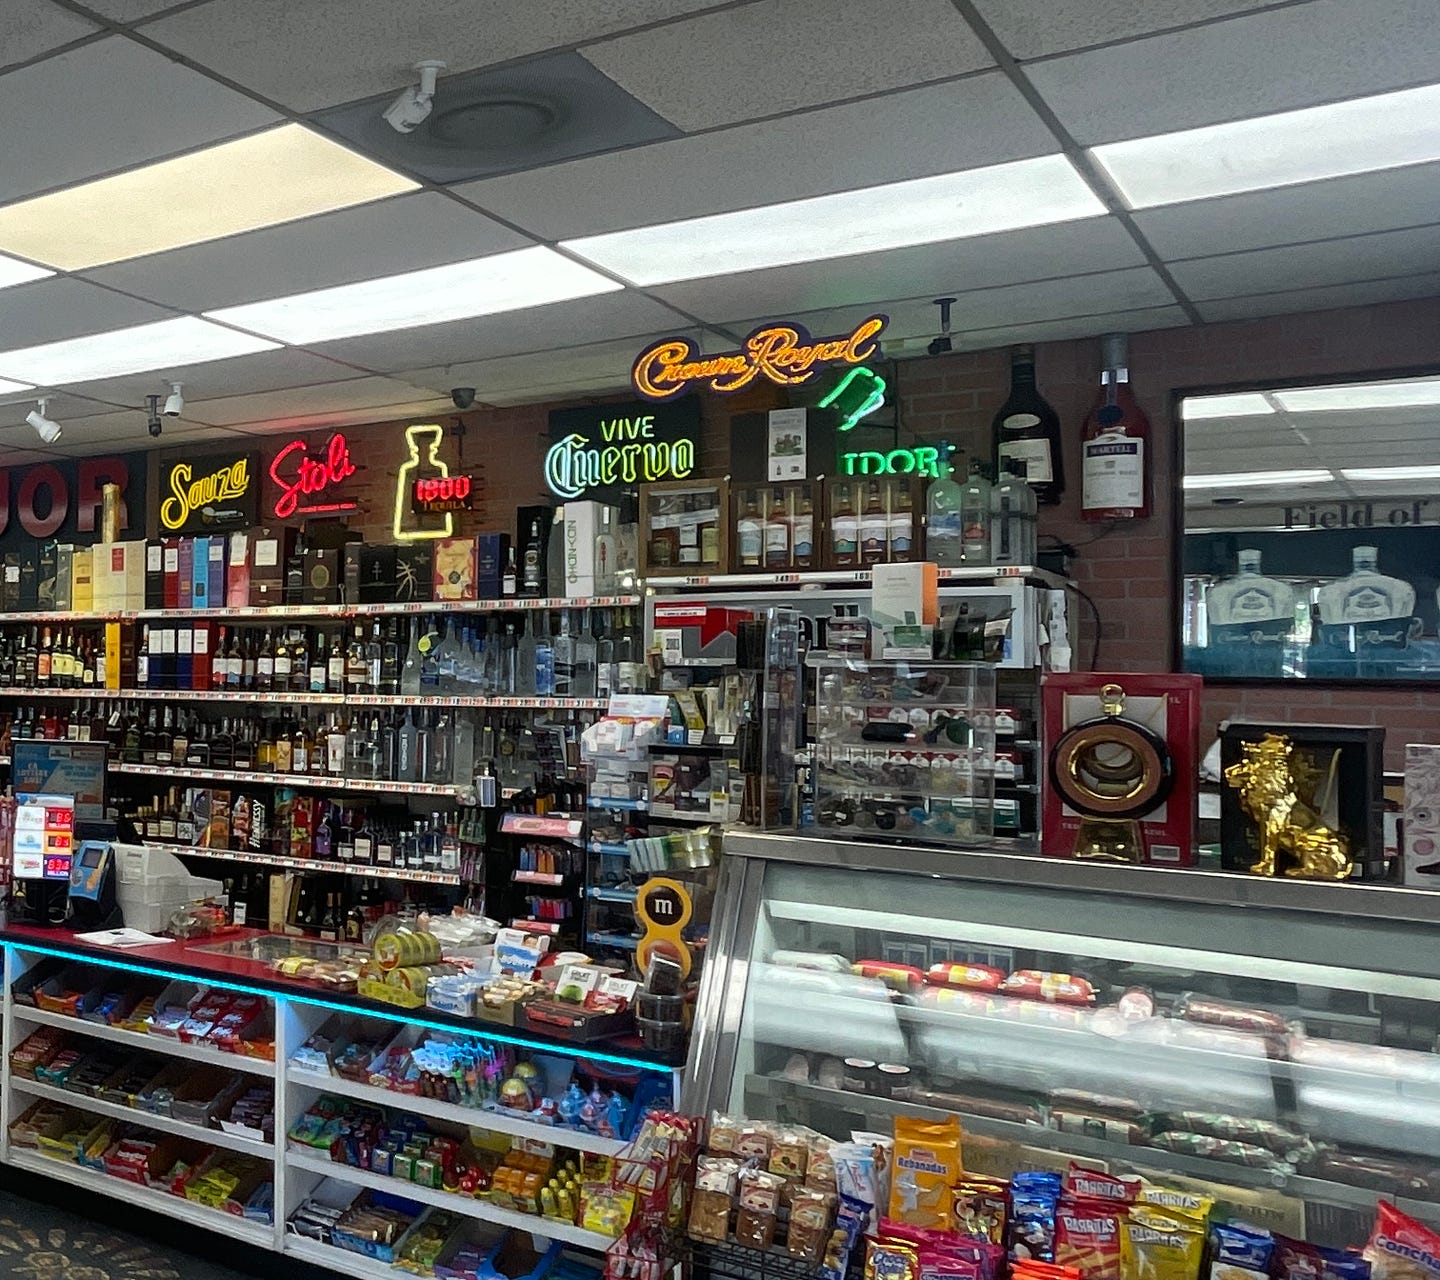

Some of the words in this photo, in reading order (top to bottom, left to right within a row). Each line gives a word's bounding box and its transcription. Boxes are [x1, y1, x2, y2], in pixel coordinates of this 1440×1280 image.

[633, 341, 750, 397] Crown
[716, 318, 883, 392] Royal
[601, 416, 654, 442] VIVE
[269, 433, 356, 518] Stoli
[545, 433, 694, 499] Cuervo
[160, 458, 250, 529] Sauza
[416, 476, 470, 502] 1800
[1284, 503, 1373, 529] Field
[1388, 499, 1428, 525] of
[654, 898, 674, 916] m
[897, 1157, 948, 1175] Rebanadas
[1075, 1178, 1126, 1199] BARRITAS
[1064, 1216, 1116, 1234] BARRITAS
